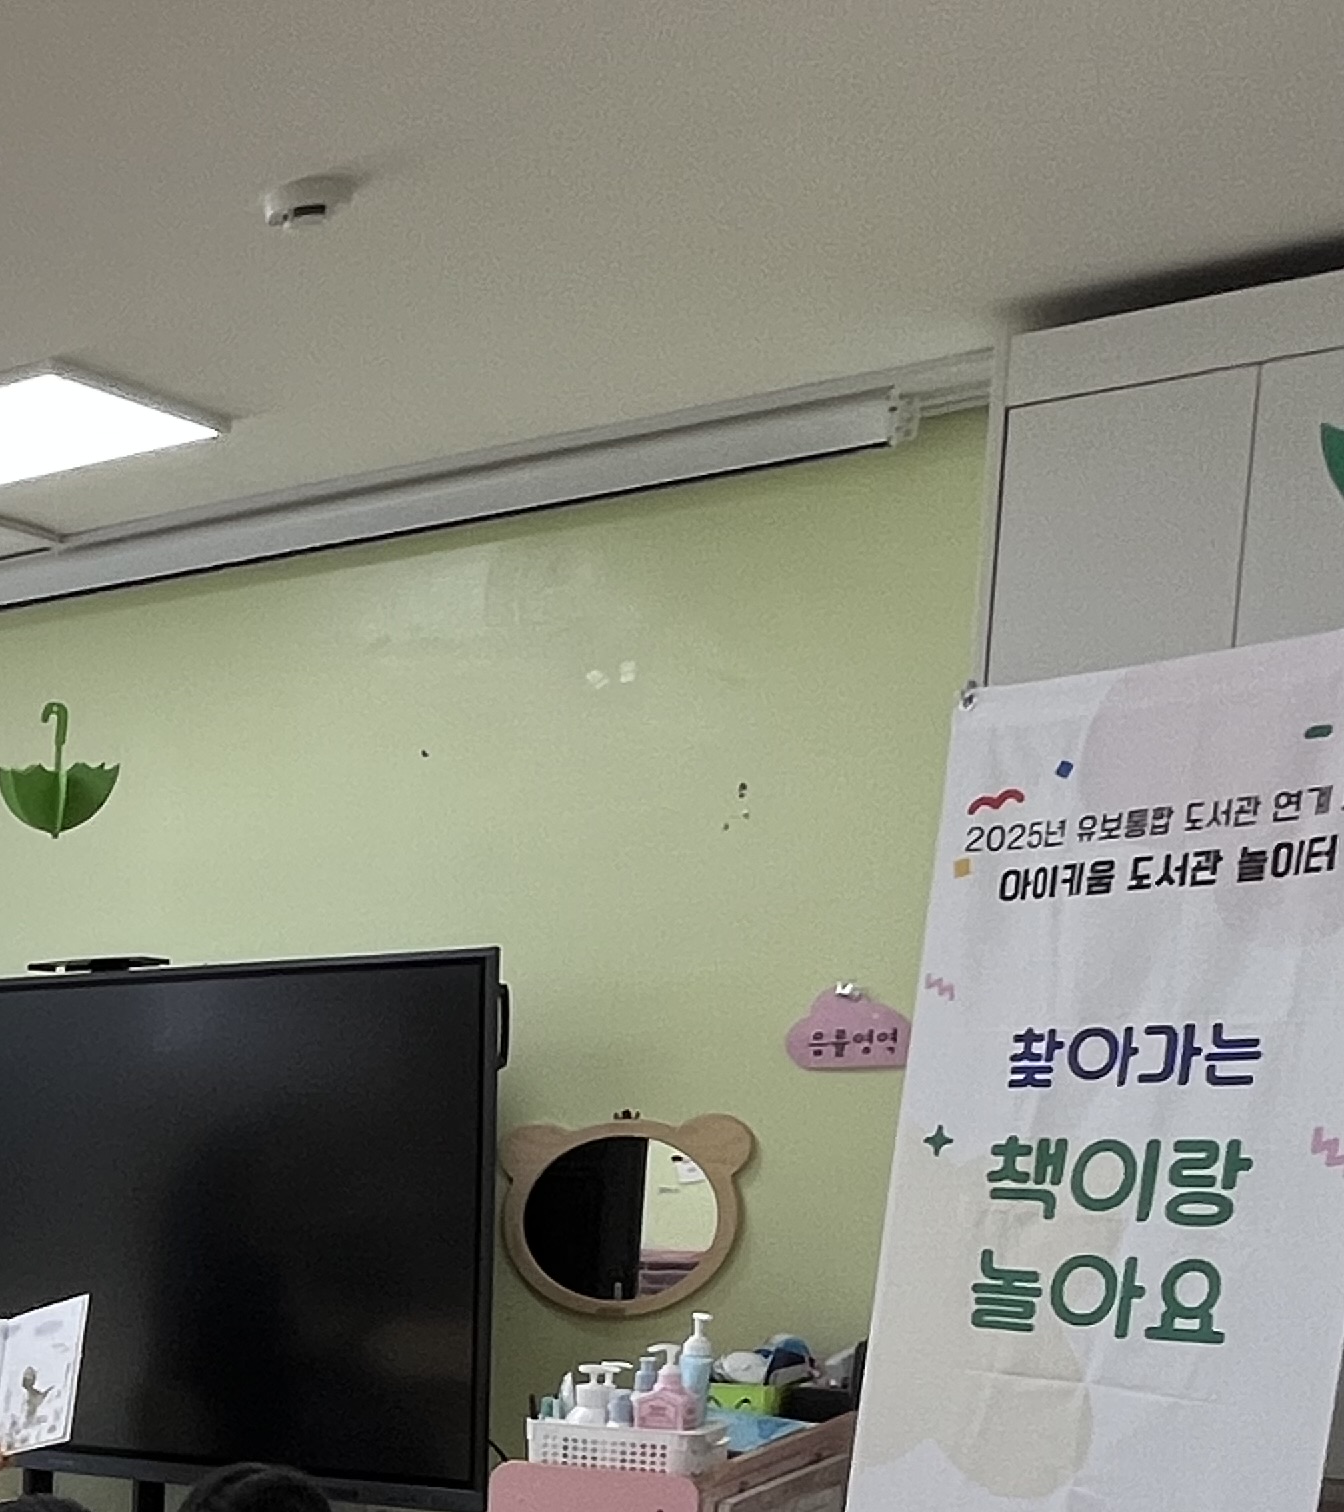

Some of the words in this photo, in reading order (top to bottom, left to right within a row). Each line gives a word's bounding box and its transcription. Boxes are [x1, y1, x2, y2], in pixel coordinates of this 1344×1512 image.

[964, 819, 1067, 852] 2025년
[1076, 805, 1175, 842] 유보통합
[1184, 794, 1262, 832] 도서관
[998, 859, 1116, 902] 아이키움
[1126, 849, 1224, 892] 도서관
[1236, 833, 1339, 884] 놀이터
[1008, 1022, 1263, 1088] 찾아가는
[986, 1134, 1254, 1228] 책이랑
[970, 1248, 1226, 1345] 놀아요
